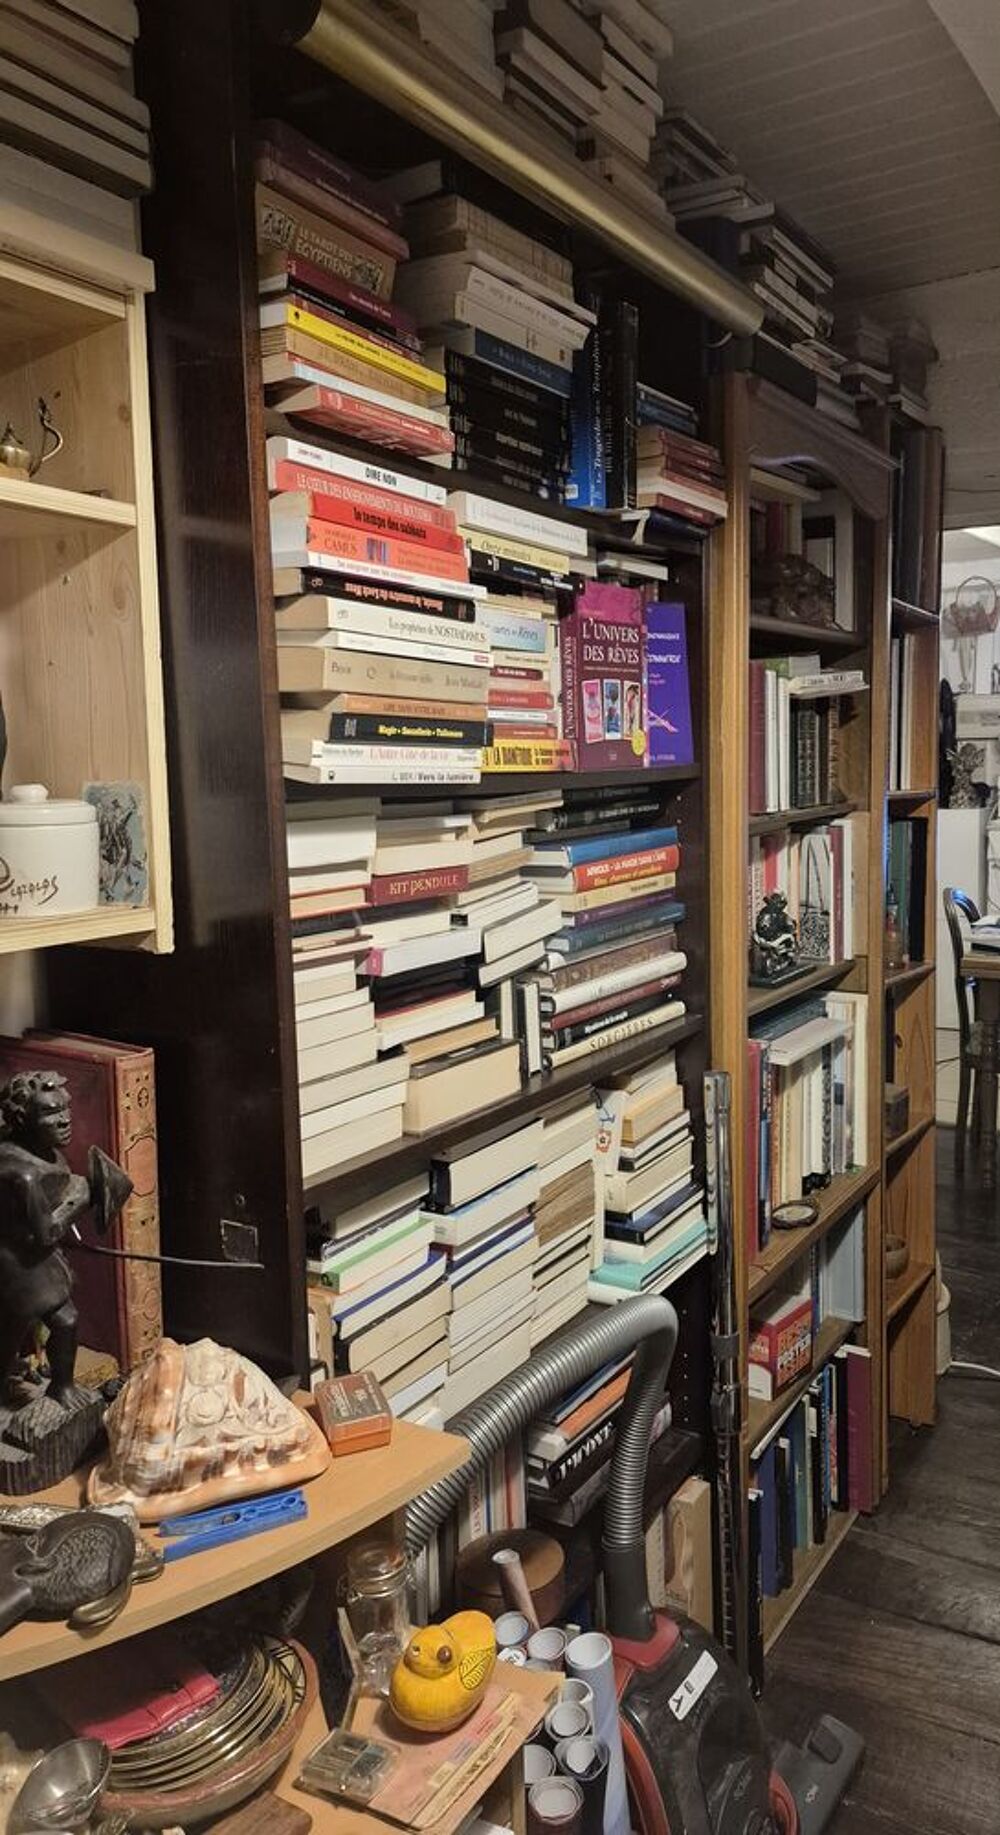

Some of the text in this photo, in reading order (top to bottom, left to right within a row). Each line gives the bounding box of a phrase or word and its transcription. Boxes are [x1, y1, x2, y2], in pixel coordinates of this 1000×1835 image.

[365, 467, 397, 487] DIRE NON
[362, 510, 384, 529] temps
[386, 517, 398, 533] des
[582, 617, 640, 644] L'UNIVERS
[583, 648, 605, 662] DES
[608, 642, 640, 664] RÊVES
[446, 772, 473, 780] lumière
[390, 880, 408, 895] KIT
